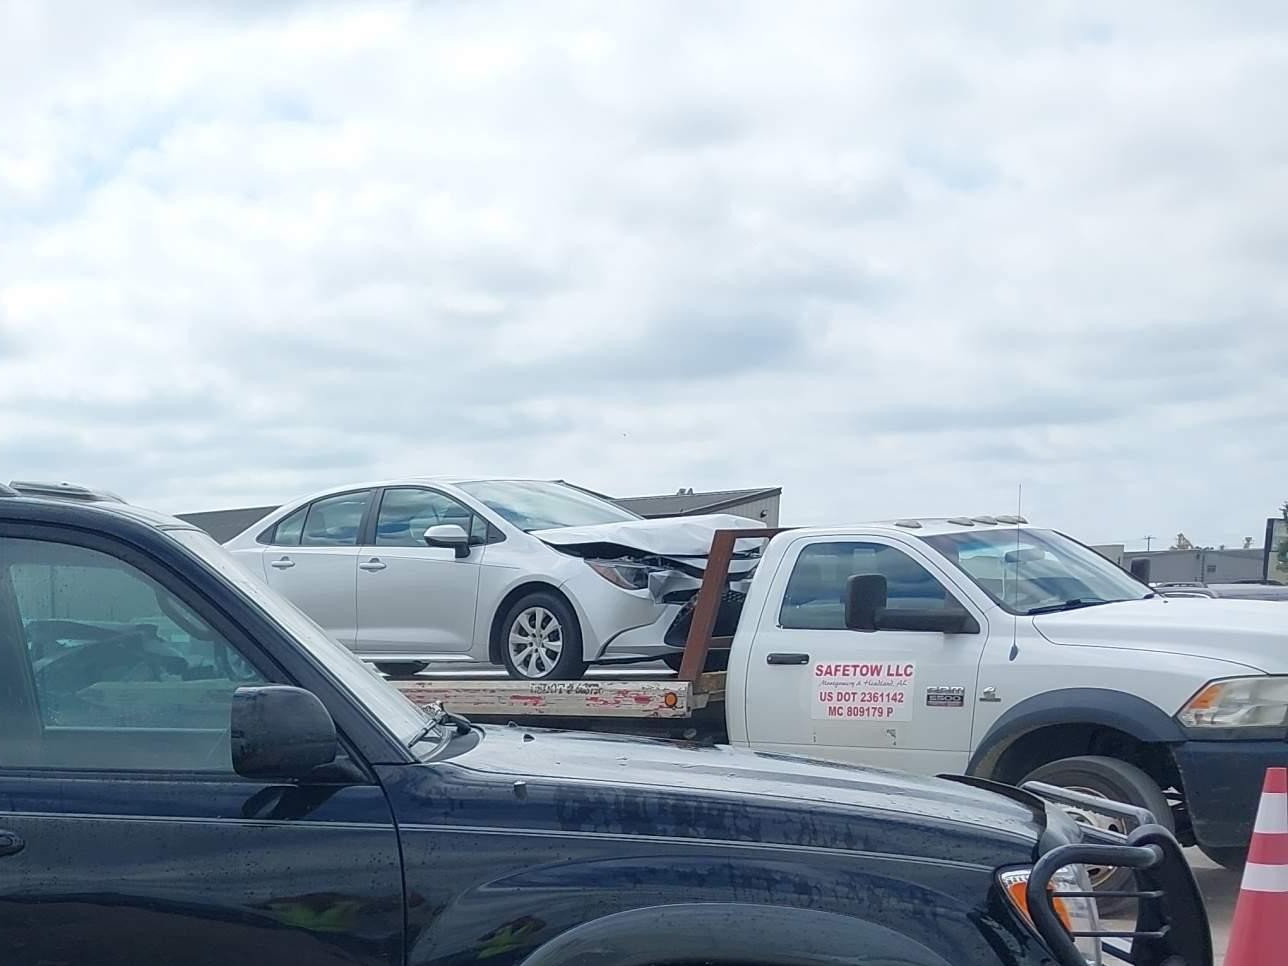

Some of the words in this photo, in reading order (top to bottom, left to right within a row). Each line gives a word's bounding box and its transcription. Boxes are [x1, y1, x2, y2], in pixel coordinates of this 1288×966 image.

[815, 664, 883, 677] SAFETOW
[886, 664, 914, 677] LLC
[819, 692, 833, 702] US
[836, 692, 858, 702] DOT
[860, 692, 904, 703] 2361142
[828, 706, 844, 716] MC
[846, 707, 884, 717] 809179
[886, 707, 894, 717] P
